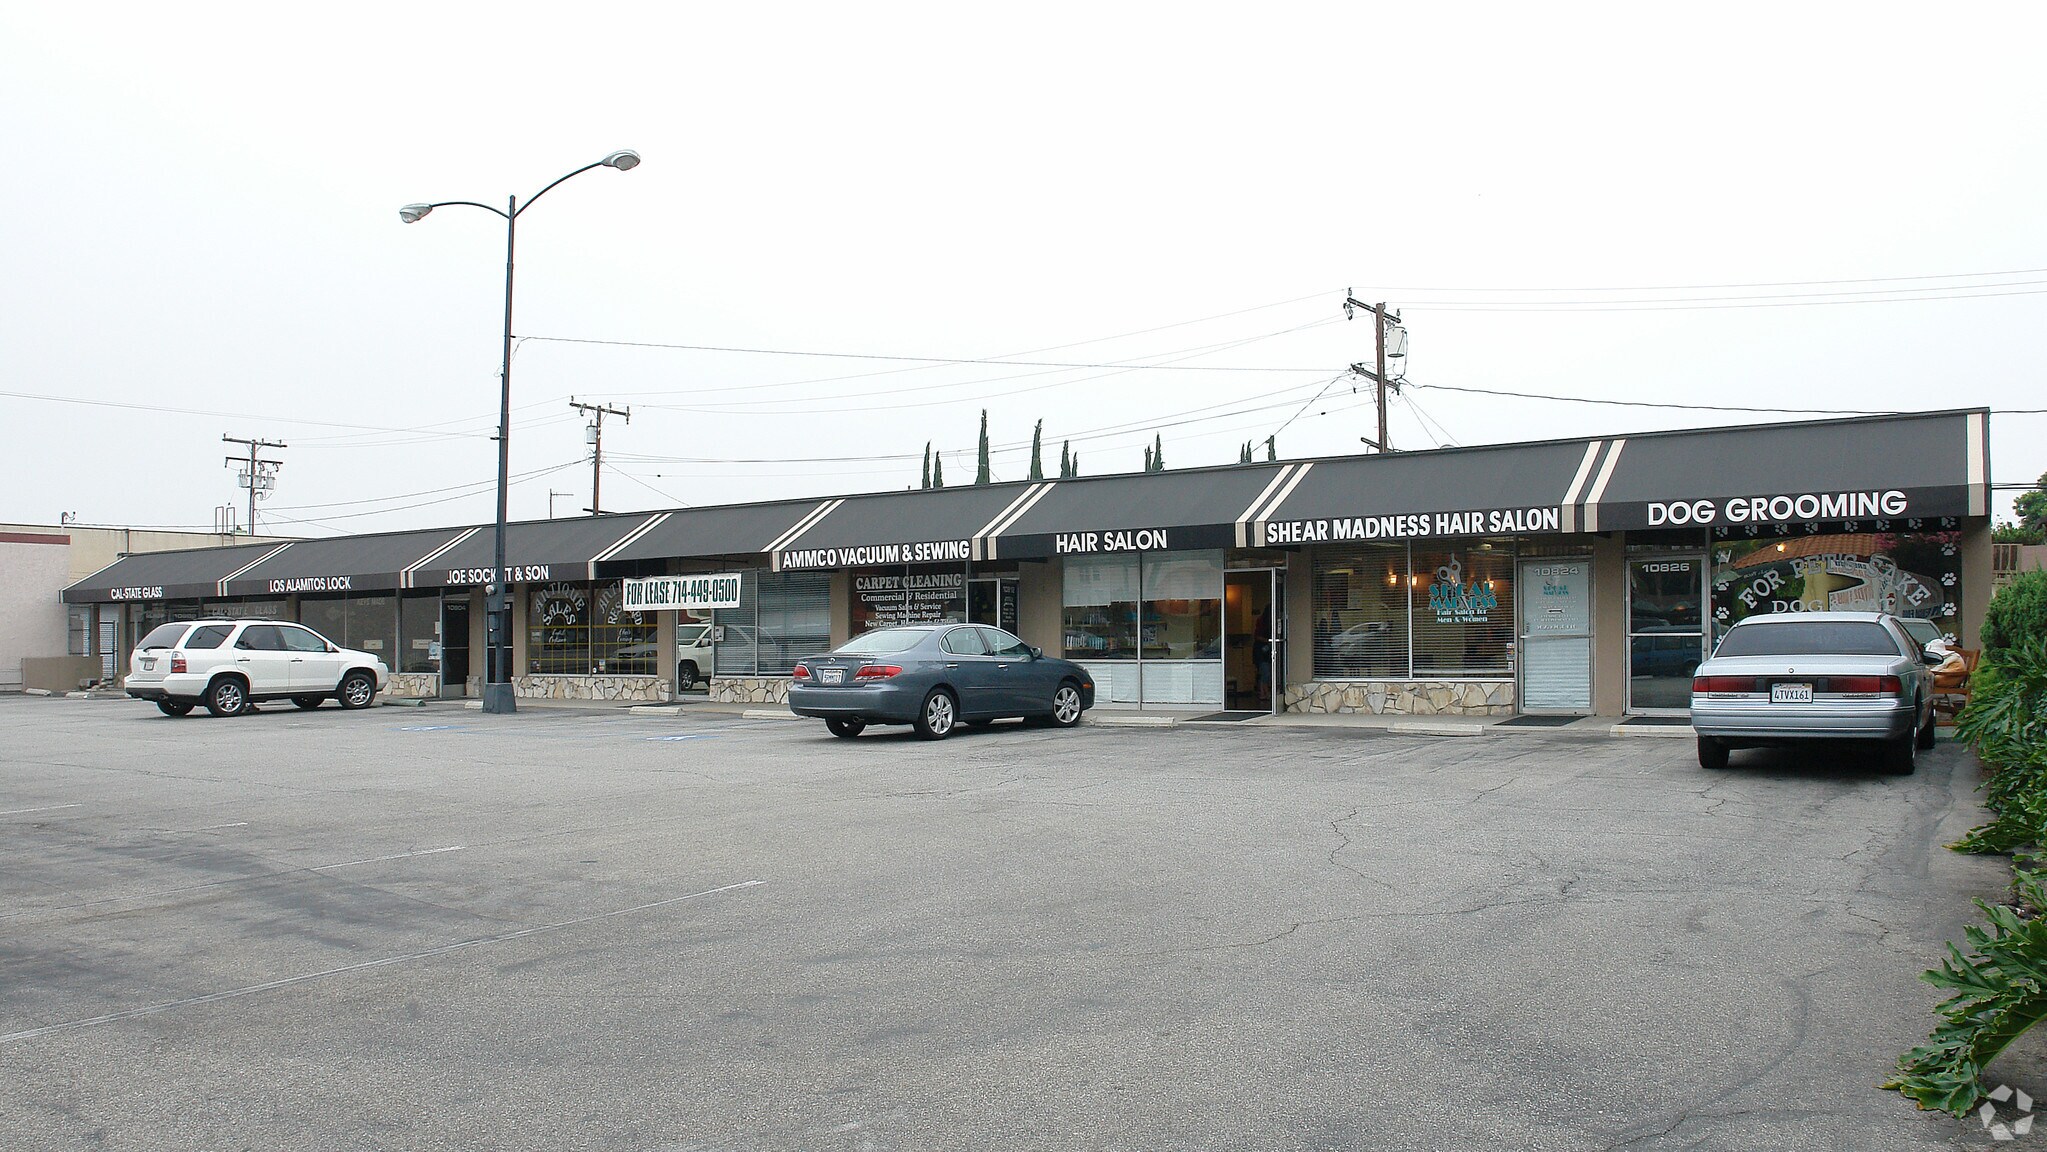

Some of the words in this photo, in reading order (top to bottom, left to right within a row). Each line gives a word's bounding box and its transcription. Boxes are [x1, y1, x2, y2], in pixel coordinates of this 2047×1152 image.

[1647, 499, 1716, 526] DOG
[1725, 490, 1908, 522] GROOMING
[1267, 520, 1328, 543] SHEAR
[1333, 514, 1430, 540] MADNESS
[1435, 511, 1484, 535] HAIR
[1489, 507, 1559, 533] SALON
[1056, 532, 1099, 554] HAIR
[1103, 529, 1168, 551] SALON
[782, 549, 837, 569] AMMCO
[839, 544, 900, 566] VACUUM
[901, 544, 914, 562] &
[914, 540, 970, 561] SEWING
[446, 569, 466, 584] JOE
[467, 566, 513, 583] SOCKT
[514, 566, 524, 582] &
[525, 565, 550, 581] SON
[1534, 567, 1579, 576] 10824
[1642, 563, 1690, 573] 10826
[269, 579, 285, 592] LOS
[285, 577, 326, 592] ALAMITOS
[326, 576, 352, 590] LOCK
[856, 576, 900, 589] CARPET
[902, 573, 962, 588] CLEANING
[1738, 569, 1786, 609] FOR
[1789, 553, 1858, 579] PET'S
[1866, 555, 1931, 607] SAKE
[110, 587, 142, 599] CAL-STATE
[142, 586, 163, 598] GLASS
[535, 581, 586, 613] ANTIQUE
[598, 580, 622, 614] ANTI
[626, 583, 643, 606] FOR
[645, 581, 670, 605] LEASE
[672, 578, 738, 604] 714-449-0500
[861, 592, 905, 602] Commercial
[915, 590, 958, 600] Residential
[1429, 582, 1496, 598] SHEAR
[254, 604, 278, 615] GLASS
[898, 603, 913, 611] Saes
[920, 602, 942, 610] Service
[1428, 595, 1498, 610] MADNESS
[1771, 600, 1823, 613] DOG
[542, 601, 576, 626] SALES
[875, 612, 896, 620] Sewing
[897, 611, 920, 619] Mahine
[921, 610, 942, 619] Repair
[1774, 690, 1809, 700] 4TVX161
